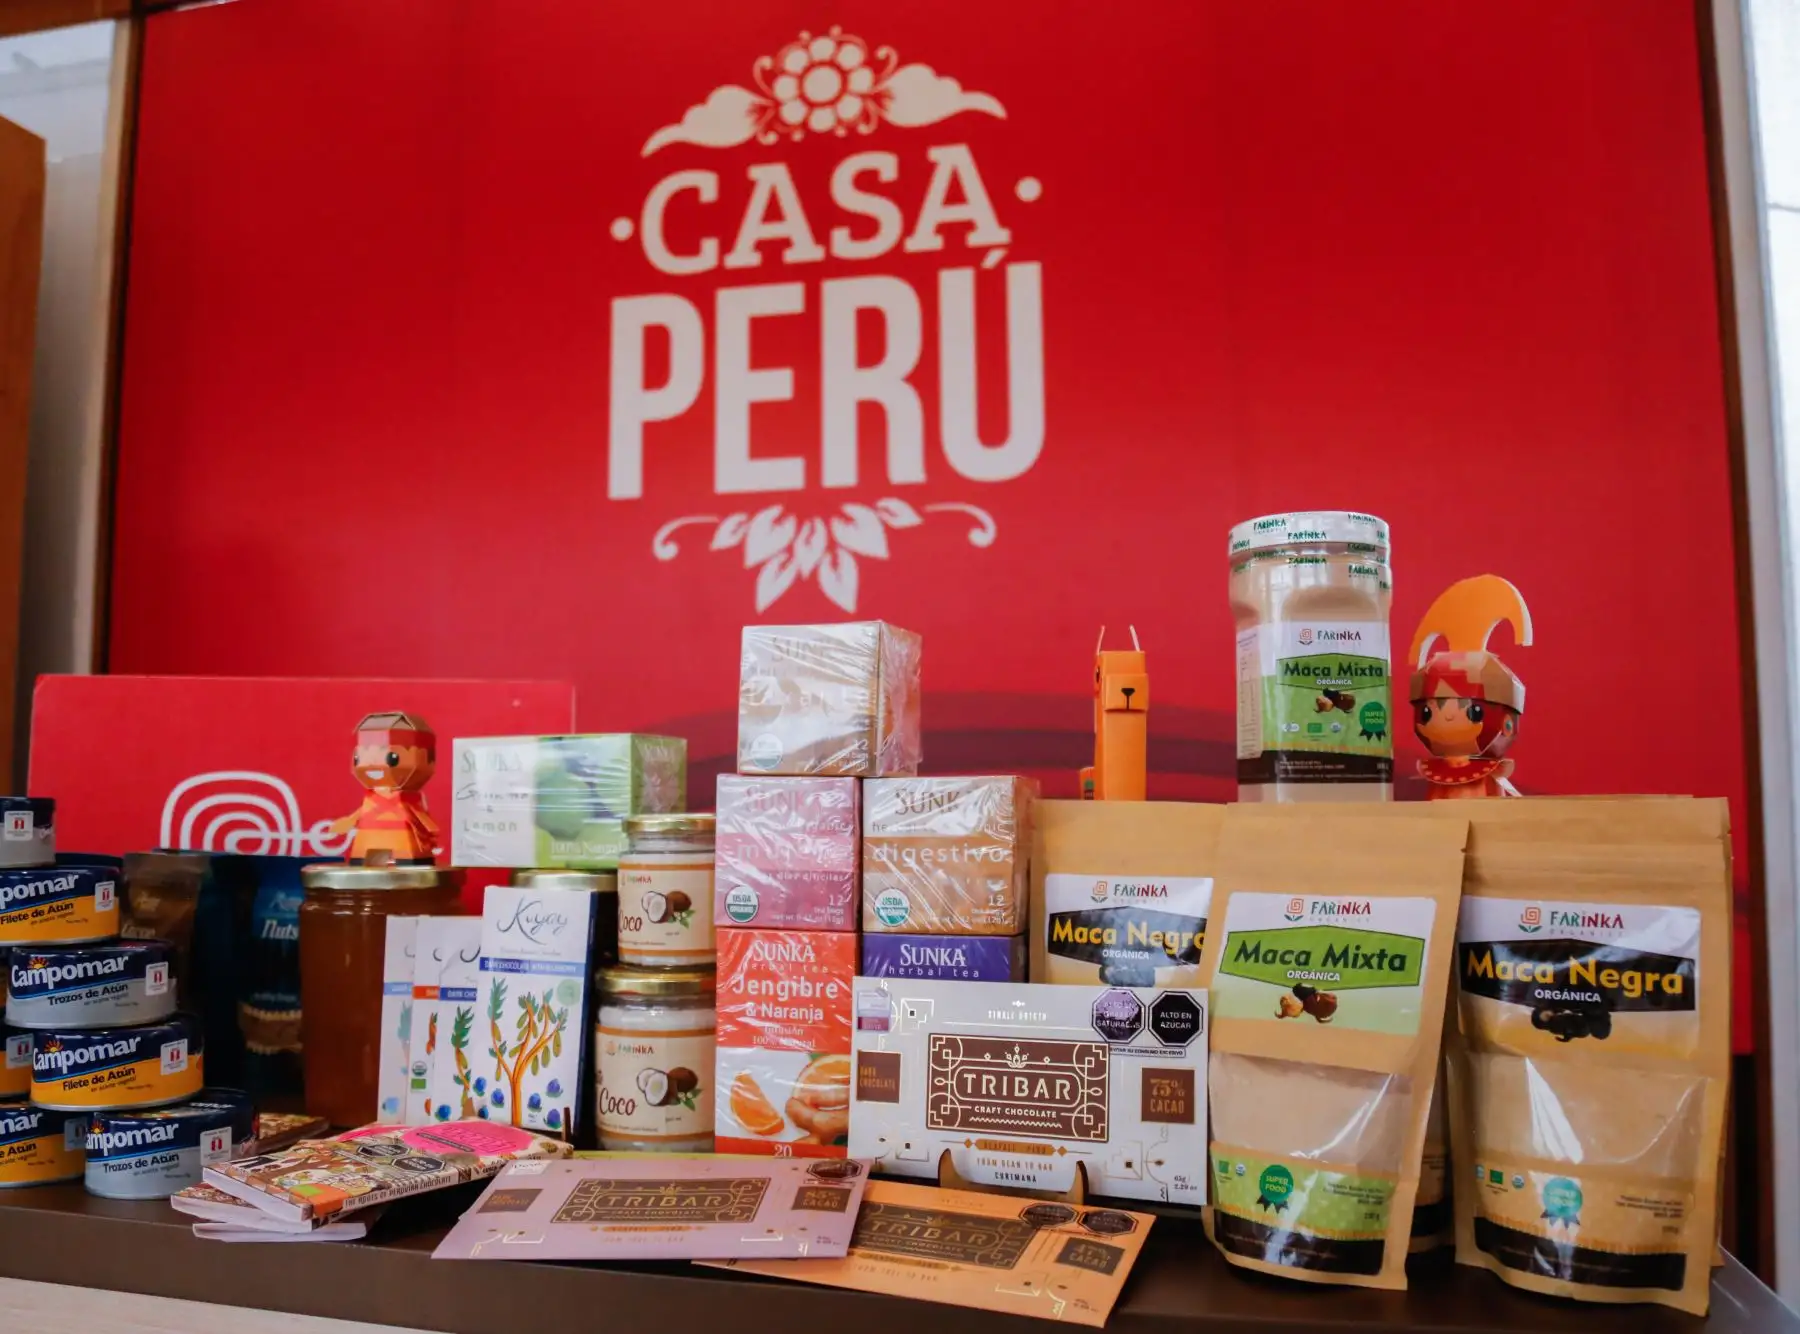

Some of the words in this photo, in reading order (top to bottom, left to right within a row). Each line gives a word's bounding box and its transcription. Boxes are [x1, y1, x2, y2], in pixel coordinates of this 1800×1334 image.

[641, 144, 1011, 275] CASA
[608, 249, 1045, 500] PERÚ
[1253, 518, 1287, 531] FARINKA
[1287, 530, 1327, 540] FARINKA
[1317, 630, 1362, 641] FARINKA
[1284, 661, 1331, 677] Maca
[1337, 661, 1383, 677] Mixta
[874, 843, 1005, 867] digestivo
[1113, 883, 1168, 897] FARINKA
[0, 912, 29, 925] Filete
[31, 909, 45, 918] de
[1311, 901, 1371, 915] FARINKA
[1550, 911, 1624, 928] FARINKA
[1053, 917, 1117, 944] Maca
[753, 940, 816, 962] SUNKA
[900, 943, 967, 966] SUNKA
[1234, 940, 1312, 967] Maca
[1321, 942, 1407, 972] Mixta
[12, 956, 129, 989] Campomar
[888, 965, 942, 977] herbal
[953, 968, 980, 978] tea
[1287, 969, 1340, 981] ORGÁNICA
[1467, 949, 1554, 985] Maca
[1569, 956, 1683, 998] Negra
[48, 992, 83, 1006] Trozos
[85, 988, 99, 998] de
[732, 976, 838, 1002] Jengibre
[1534, 988, 1601, 1002] ORGÁNICA
[761, 1001, 824, 1024] Naranja
[1160, 1011, 1179, 1019] ALTO
[1181, 1012, 1192, 1020] EN
[33, 1036, 141, 1074] Campomar
[62, 1079, 90, 1092] Filete
[91, 1075, 105, 1085] de
[107, 1067, 136, 1081] Atún
[963, 1073, 1071, 1100] TRIBAR
[1150, 1078, 1185, 1097] 75%
[600, 1087, 636, 1116] Coco
[1150, 1098, 1185, 1114] CACAO
[974, 1105, 1002, 1115] CRAFT
[1005, 1108, 1057, 1119] CHOCOLATE
[85, 1123, 179, 1156] ampomar
[772, 1143, 793, 1157] 20
[103, 1162, 132, 1173] Trozos
[134, 1158, 149, 1168] de
[150, 1153, 180, 1165] Atún
[1265, 1183, 1288, 1193] FOOD
[1266, 1175, 1289, 1185] SUPER
[607, 1196, 722, 1207] TRIBAR
[871, 1220, 988, 1245] TRIBAR
